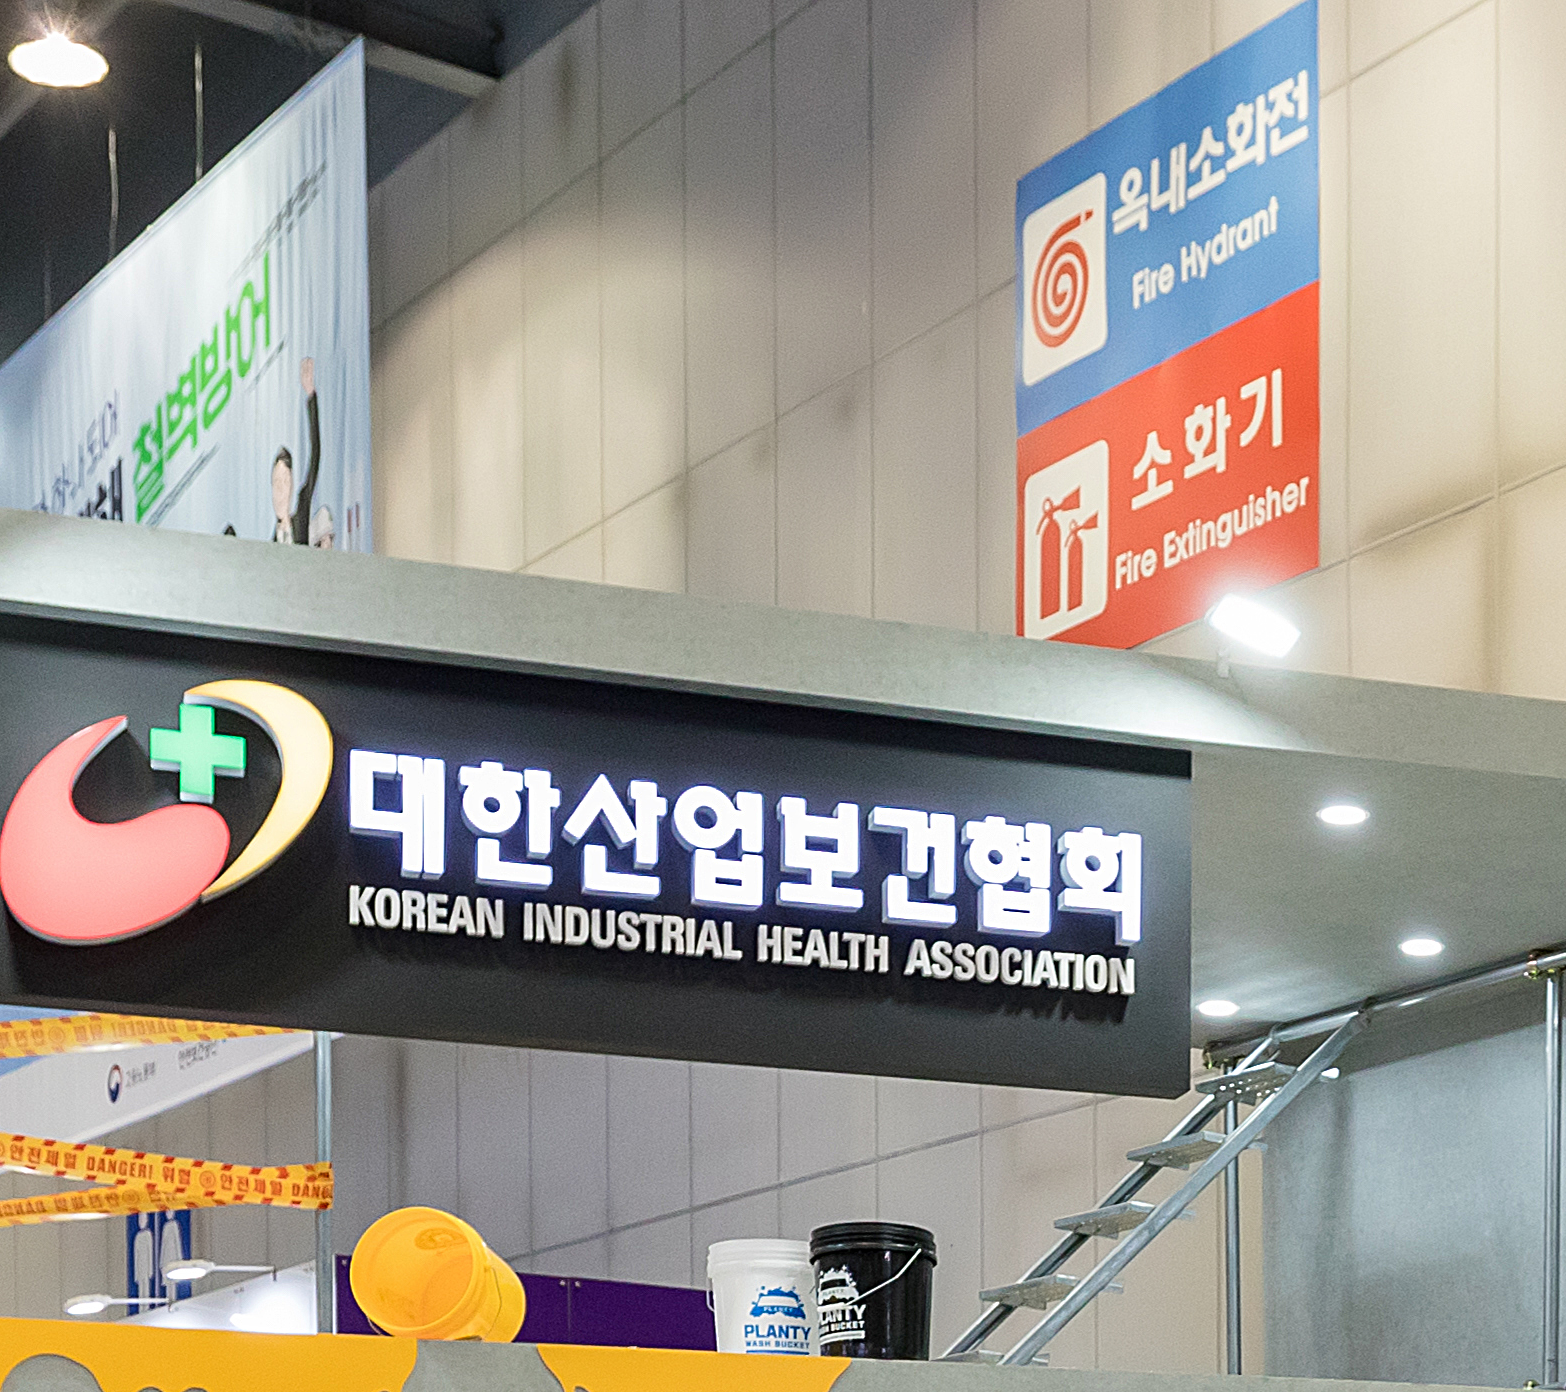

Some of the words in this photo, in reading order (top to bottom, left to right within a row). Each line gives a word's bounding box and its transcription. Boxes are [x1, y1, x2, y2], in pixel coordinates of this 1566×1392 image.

[1111, 68, 1311, 236] 옥내소화전
[1132, 262, 1175, 310] Fire
[1180, 195, 1279, 284] Hydrant
[131, 250, 272, 523] 철벽방어
[1131, 367, 1283, 511] 소화기
[1115, 548, 1157, 592] Fire
[1162, 476, 1310, 570] Extinguisher
[347, 747, 1144, 948] 대한산업보건협회
[347, 884, 505, 939] KOREAN
[522, 899, 742, 966] INDUSTRIAL
[757, 922, 890, 976] HEALTH
[903, 937, 1137, 998] ASSOCIATION
[10, 1143, 77, 1171] 안전제일
[86, 1155, 154, 1182] DANGER!
[162, 1167, 191, 1187] 위험
[220, 1175, 283, 1197] 안전제일
[744, 1324, 812, 1341] PLANTY
[774, 1340, 810, 1349] BUCKET
